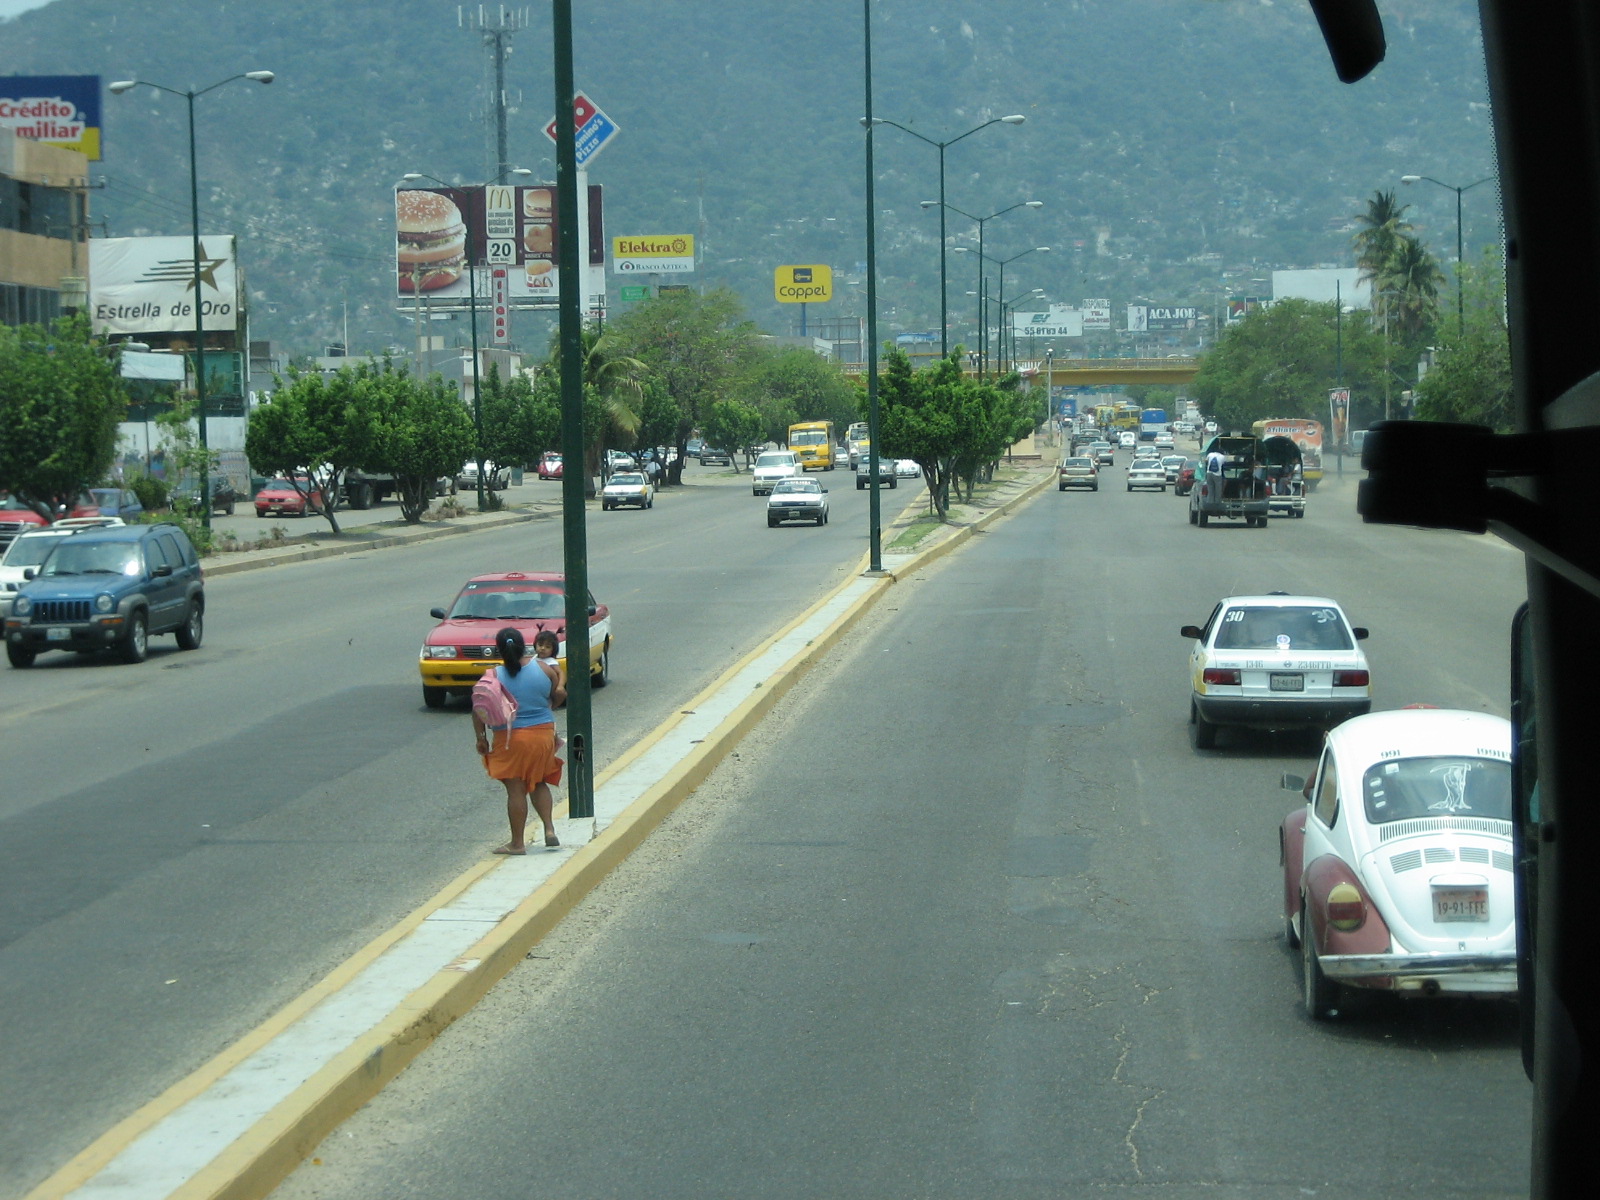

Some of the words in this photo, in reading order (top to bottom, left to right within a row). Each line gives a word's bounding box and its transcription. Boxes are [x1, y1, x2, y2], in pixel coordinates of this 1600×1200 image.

[0, 100, 72, 118] Crédito
[16, 120, 81, 138] miliar
[575, 118, 604, 149] omino's
[576, 137, 600, 161] Pizza
[619, 240, 671, 253] Elektra
[636, 263, 660, 271] BANCO
[779, 285, 827, 299] Coppel
[97, 302, 161, 320] Estrella
[171, 301, 191, 317] de
[201, 300, 231, 316] Oro
[1149, 308, 1172, 319] ACA
[1172, 307, 1196, 319] JOE
[1225, 610, 1245, 622] 30
[1311, 608, 1337, 624] 30
[1437, 901, 1487, 916] 19-91-FFE
